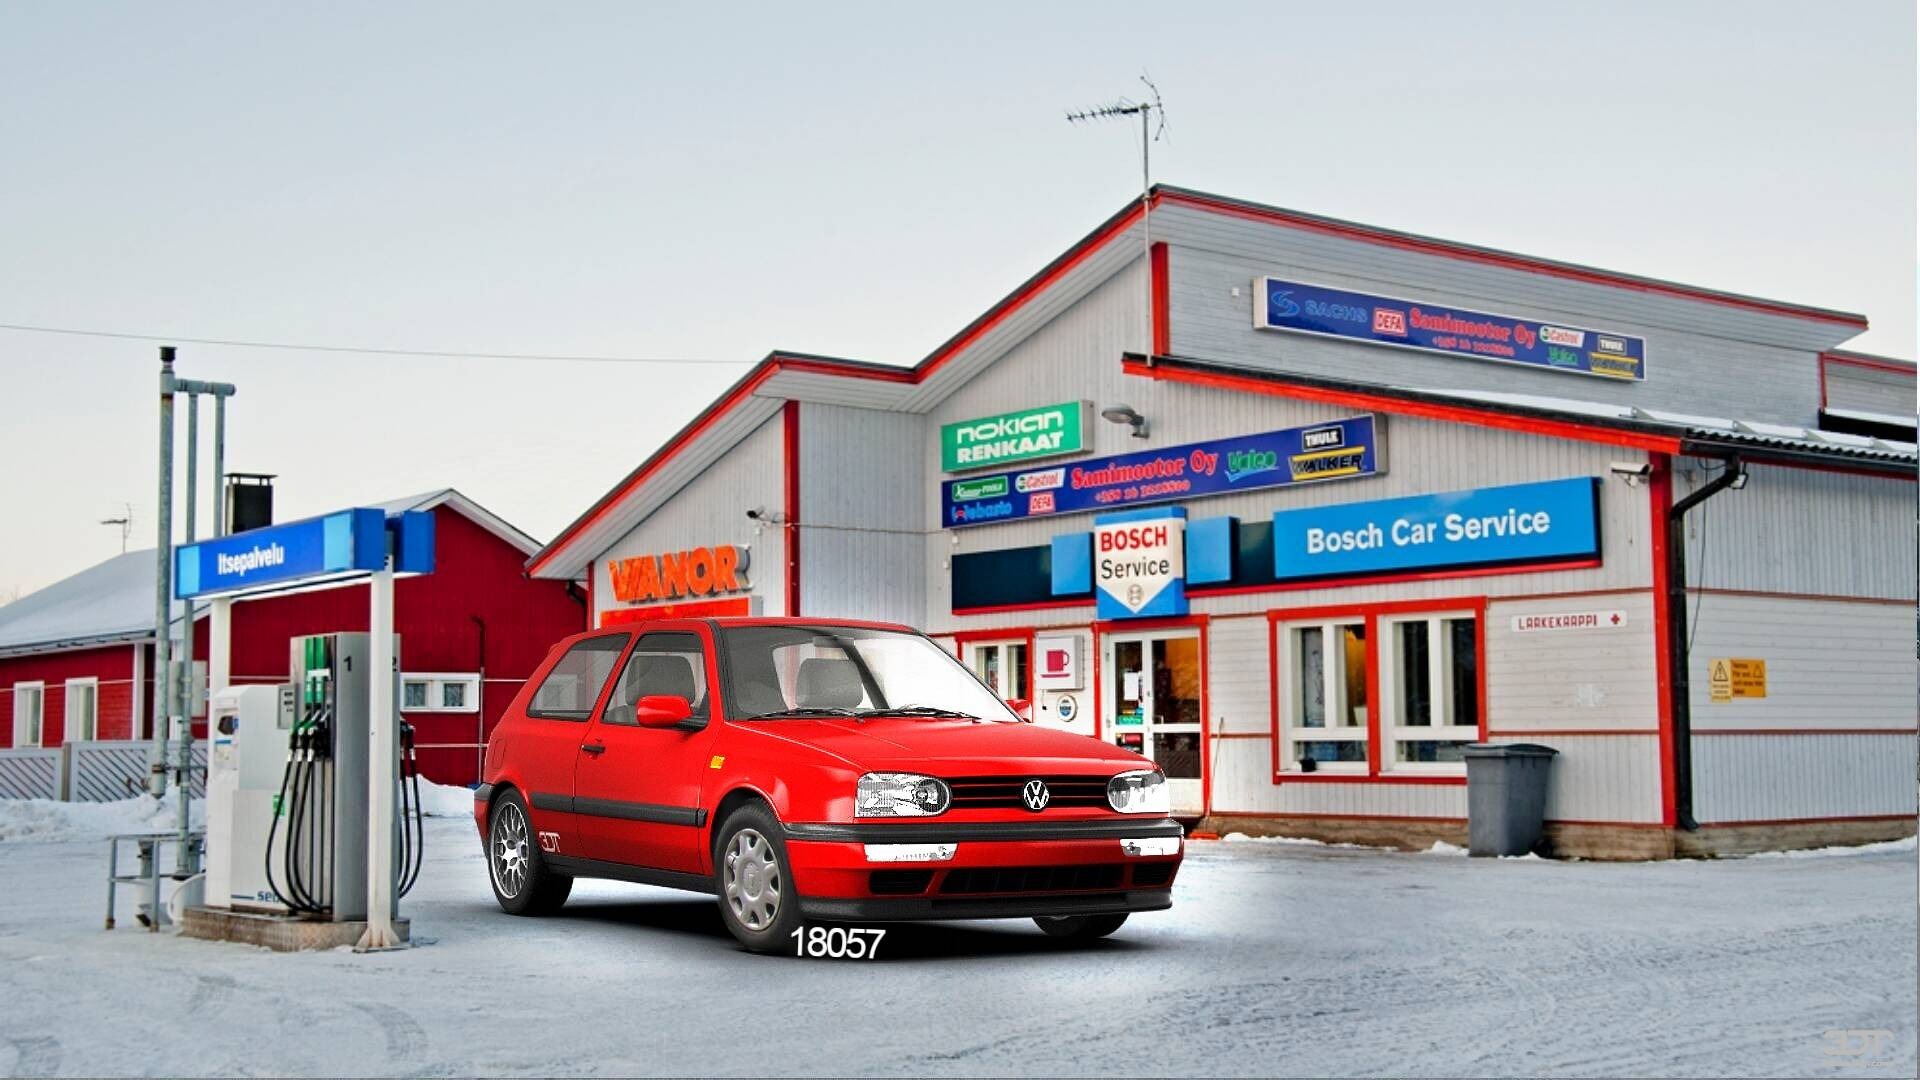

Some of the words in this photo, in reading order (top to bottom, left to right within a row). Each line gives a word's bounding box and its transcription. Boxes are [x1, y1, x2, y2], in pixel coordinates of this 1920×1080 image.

[1304, 299, 1368, 323] SACHS
[1378, 313, 1402, 331] DEFA
[1513, 324, 1536, 350] Oy
[957, 431, 1063, 462] RENKAAT
[1304, 430, 1339, 447] THULE
[1190, 449, 1219, 476] Oy
[1291, 453, 1364, 475] WALKER
[1101, 526, 1167, 552] BOSCH
[1307, 523, 1383, 554] Bosch
[1391, 518, 1437, 546] Car
[1444, 508, 1550, 541] Service
[218, 542, 284, 577] Itsepalvelu
[1101, 556, 1170, 580] Service
[343, 656, 353, 672] 1
